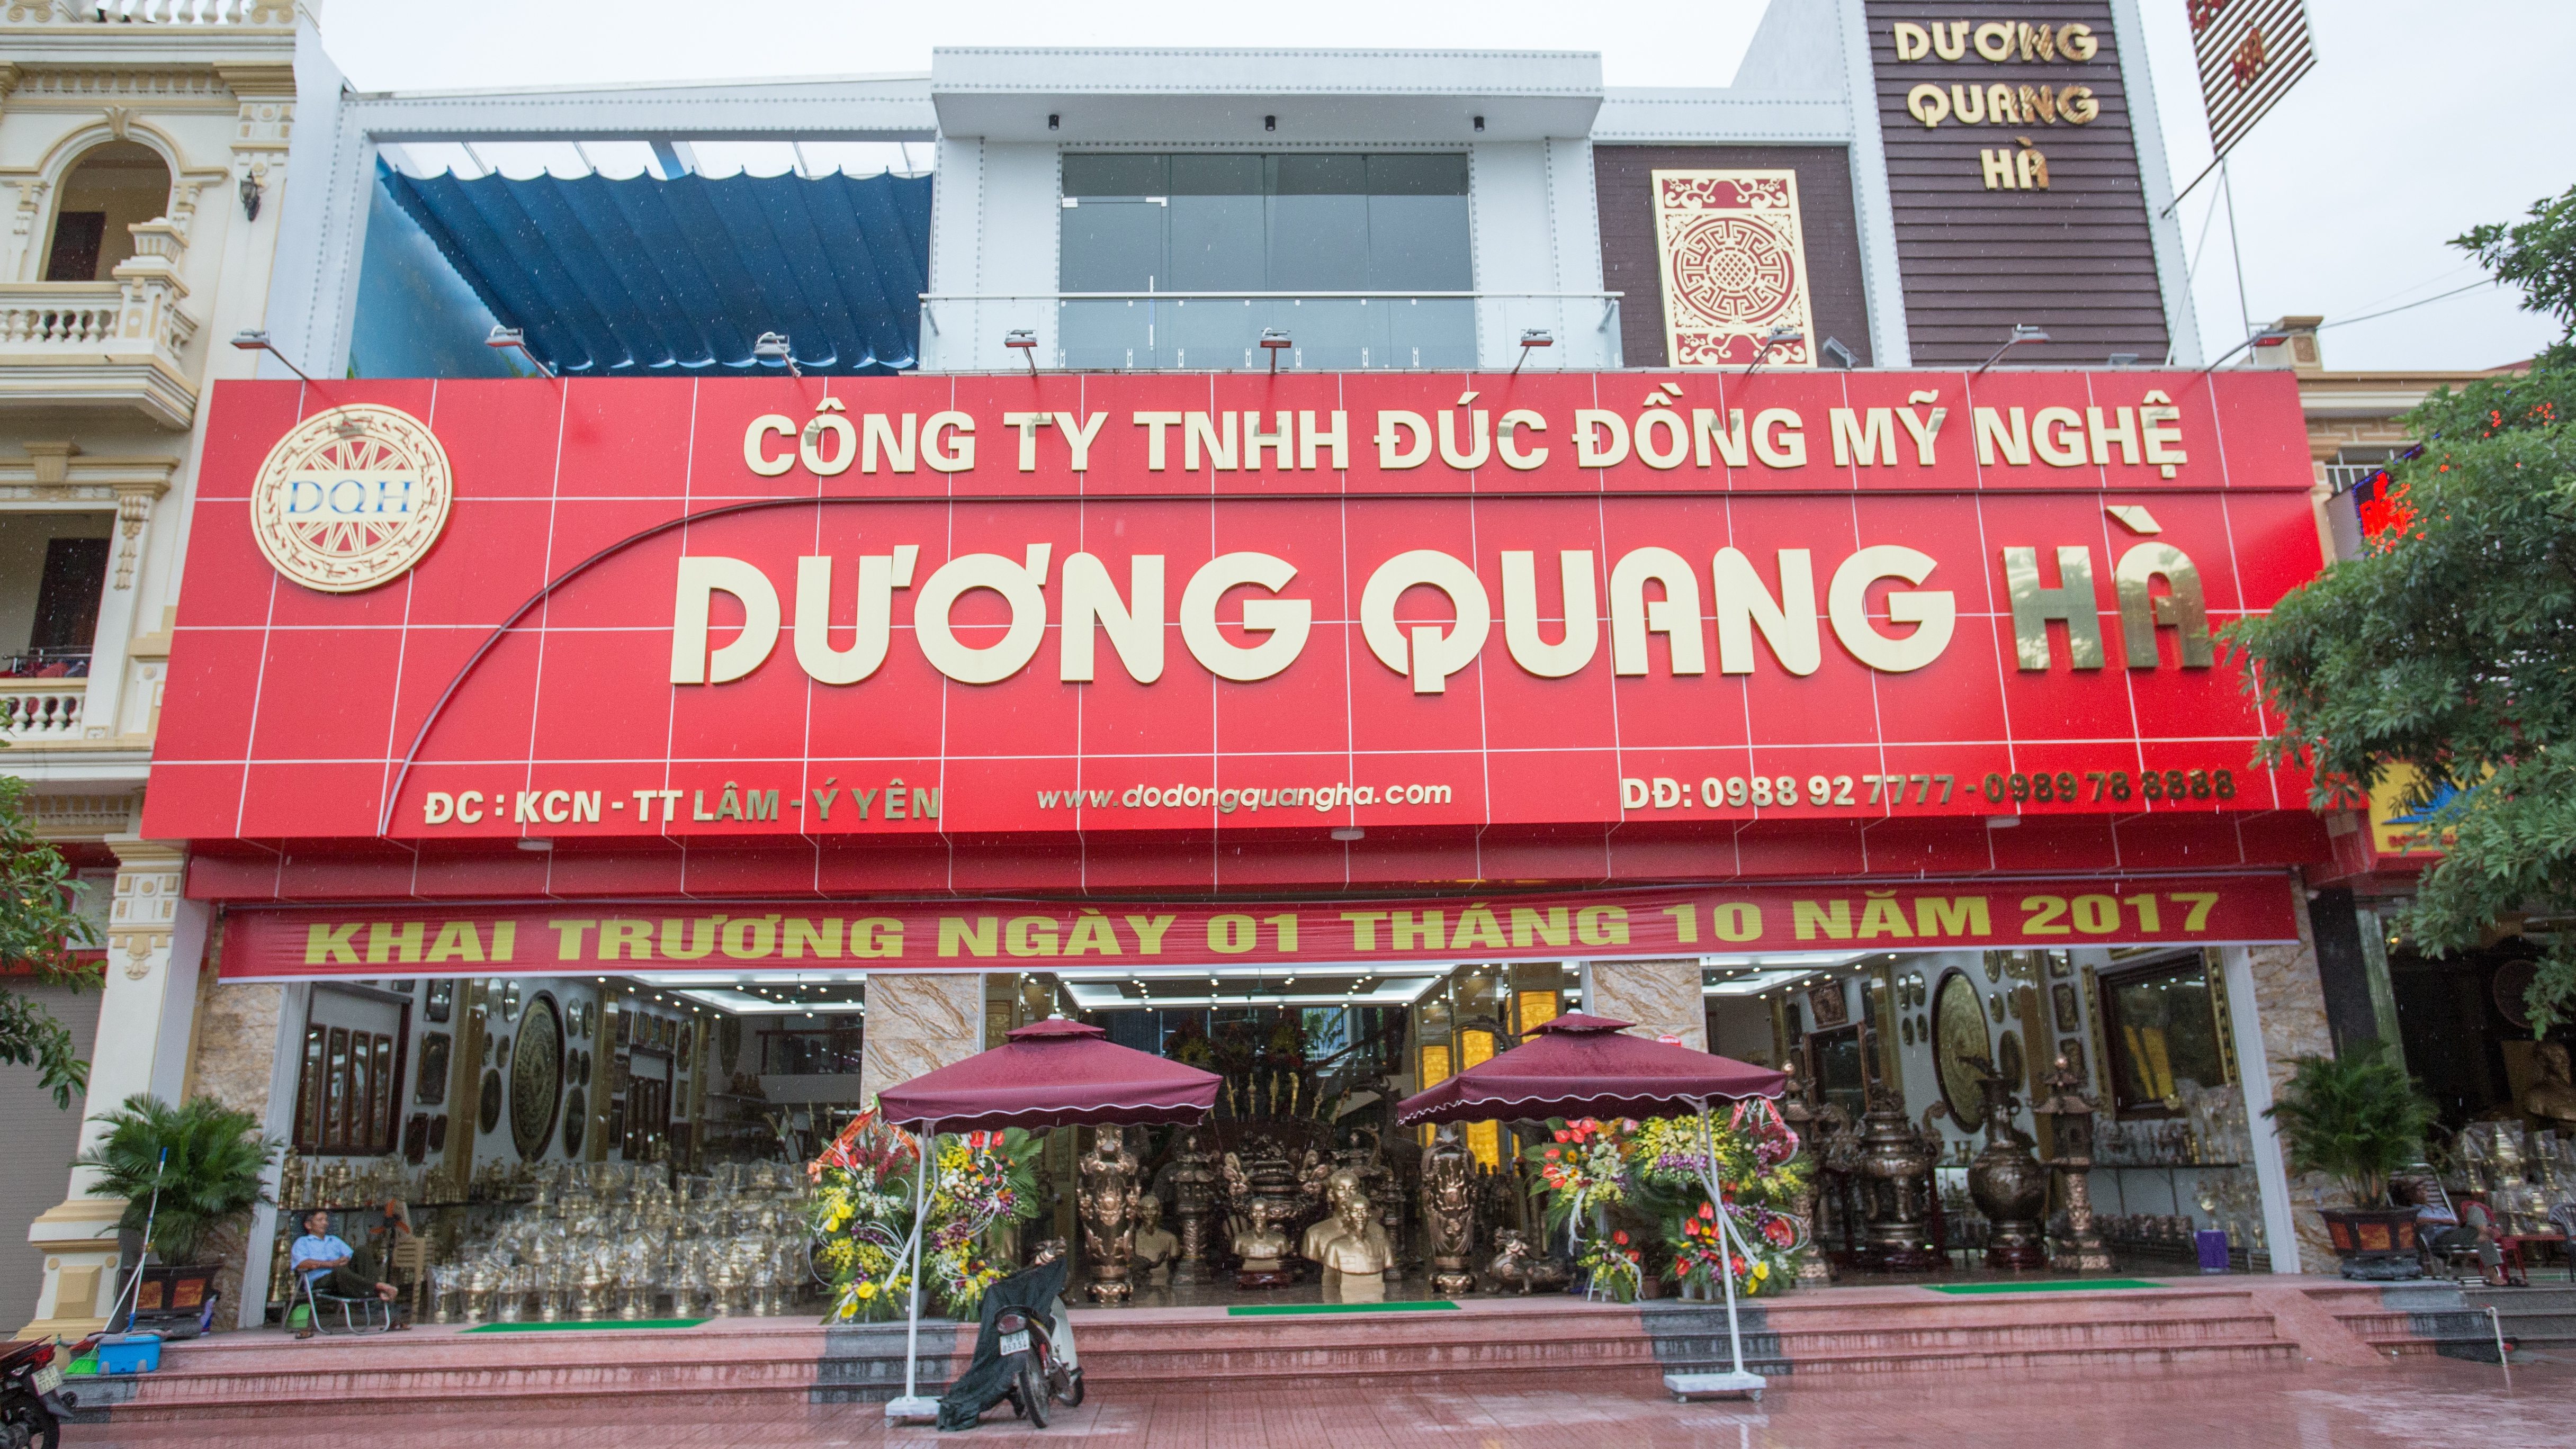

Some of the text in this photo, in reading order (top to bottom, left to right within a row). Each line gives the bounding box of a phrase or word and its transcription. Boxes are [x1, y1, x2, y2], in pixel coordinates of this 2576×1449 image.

[1894, 20, 2098, 62] DƯƠNG
[1907, 83, 2099, 127] QUANG
[1980, 136, 2049, 189] HÀ
[743, 383, 2188, 479] CÔNG TY TNHH ĐÚC ĐỒNG MỸ NGHỆ
[285, 480, 416, 514] DQH
[670, 543, 1312, 685] DƯƠNG
[1360, 544, 1955, 694] QUANG
[2003, 506, 2213, 670] HÀ
[693, 781, 779, 822] LÂM
[851, 778, 939, 820] YÊN
[1036, 782, 1452, 814] www.dodongquangha.com
[1701, 775, 1799, 809] 0988
[1808, 774, 1855, 807] 92
[2085, 770, 2131, 802] 78
[2141, 769, 2236, 800] 8888
[304, 889, 2220, 966] KHAI TRƯƠNG NGÀY 01 THÁNG 10 NĂM 2017
